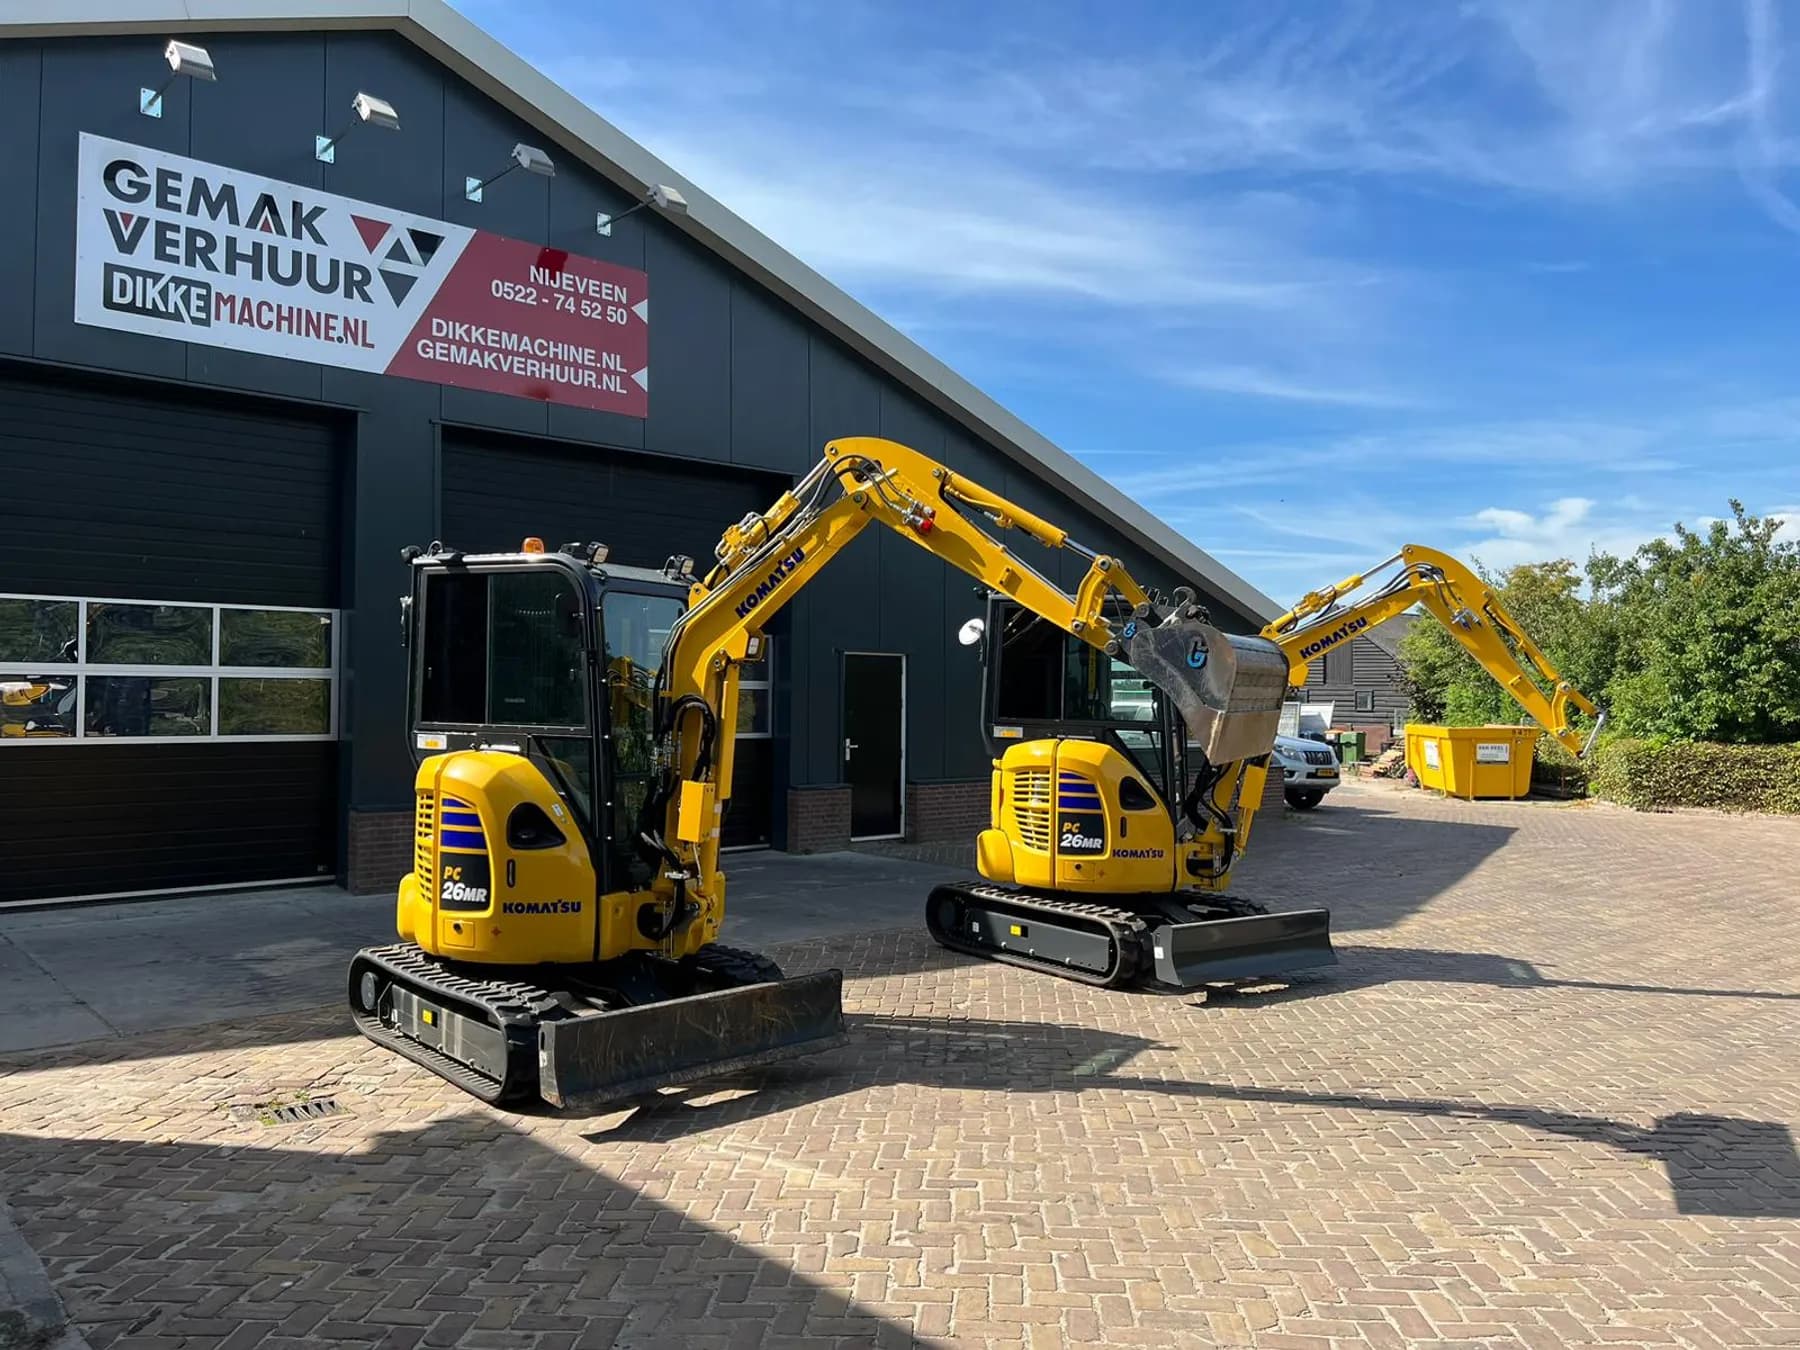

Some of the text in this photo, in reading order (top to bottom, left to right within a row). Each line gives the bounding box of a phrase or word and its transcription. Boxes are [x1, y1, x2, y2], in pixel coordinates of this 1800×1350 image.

[103, 159, 328, 246] GEMAK
[103, 208, 375, 304] VERHUUR
[491, 279, 537, 305] 0522
[553, 293, 576, 314] 74
[580, 299, 602, 320] 52
[606, 305, 627, 326] 50
[529, 265, 627, 304] NIJEVEEN
[416, 338, 627, 394] GEMAKVERHUUR.NL
[431, 318, 627, 373] DIKKEMACHINE.NL
[735, 547, 805, 618] KOMATSU
[1300, 616, 1367, 659] KOMATSU
[1060, 833, 1103, 849] 26MR
[1062, 822, 1080, 833] PC
[443, 865, 462, 881] PC
[1112, 848, 1164, 859] KOMATSU
[441, 881, 488, 902] 26MR
[503, 899, 582, 914] KOMATSU
